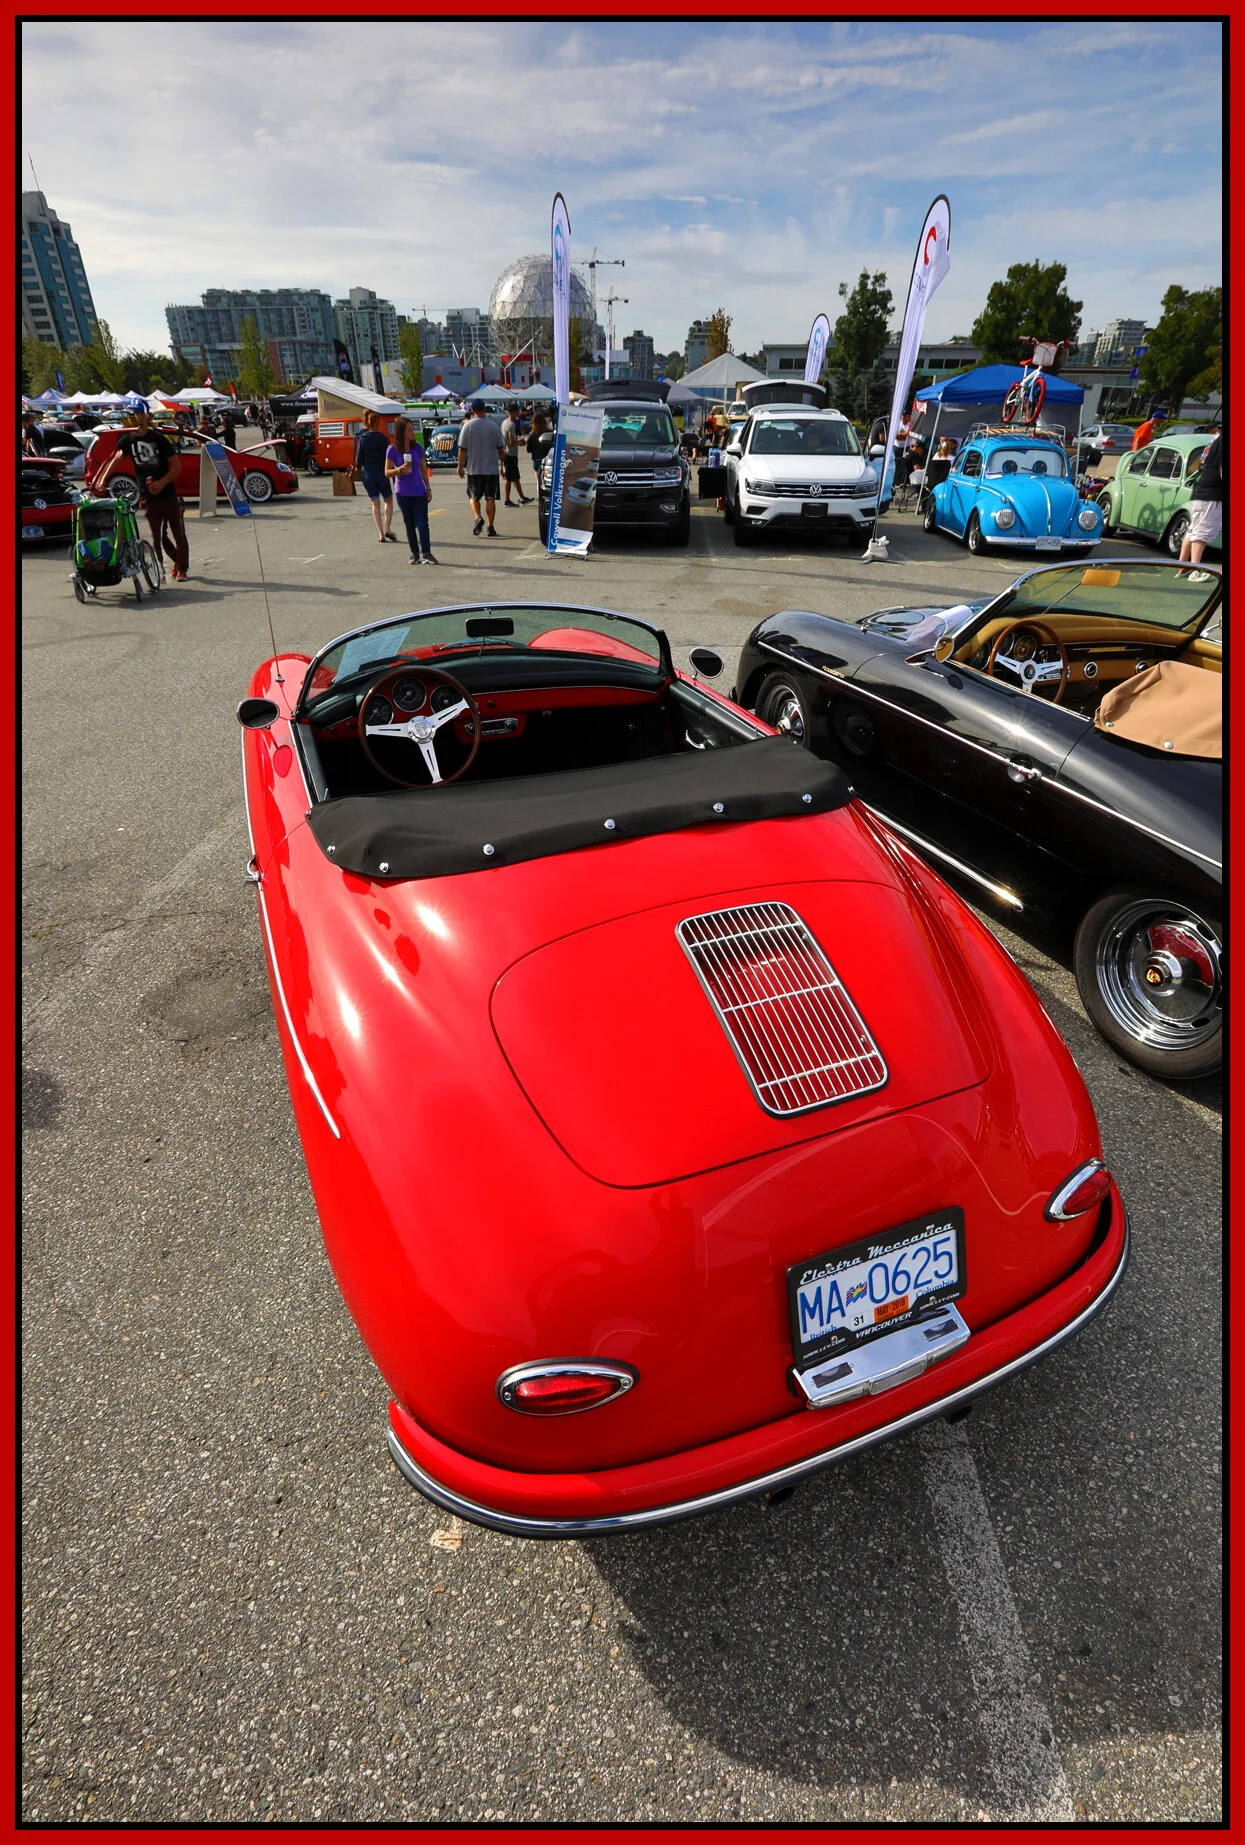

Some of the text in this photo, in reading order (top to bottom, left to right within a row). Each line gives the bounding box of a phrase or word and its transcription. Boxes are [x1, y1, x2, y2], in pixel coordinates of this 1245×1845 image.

[551, 449, 566, 546] Cowell Volkswagen
[800, 1222, 953, 1284] Electra Meccanica
[799, 1236, 953, 1334] MA 0625
[915, 1279, 954, 1298] Columbia
[853, 1315, 865, 1327] 31
[876, 1304, 889, 1317] MAY
[855, 1311, 912, 1339] VANCOUVER
